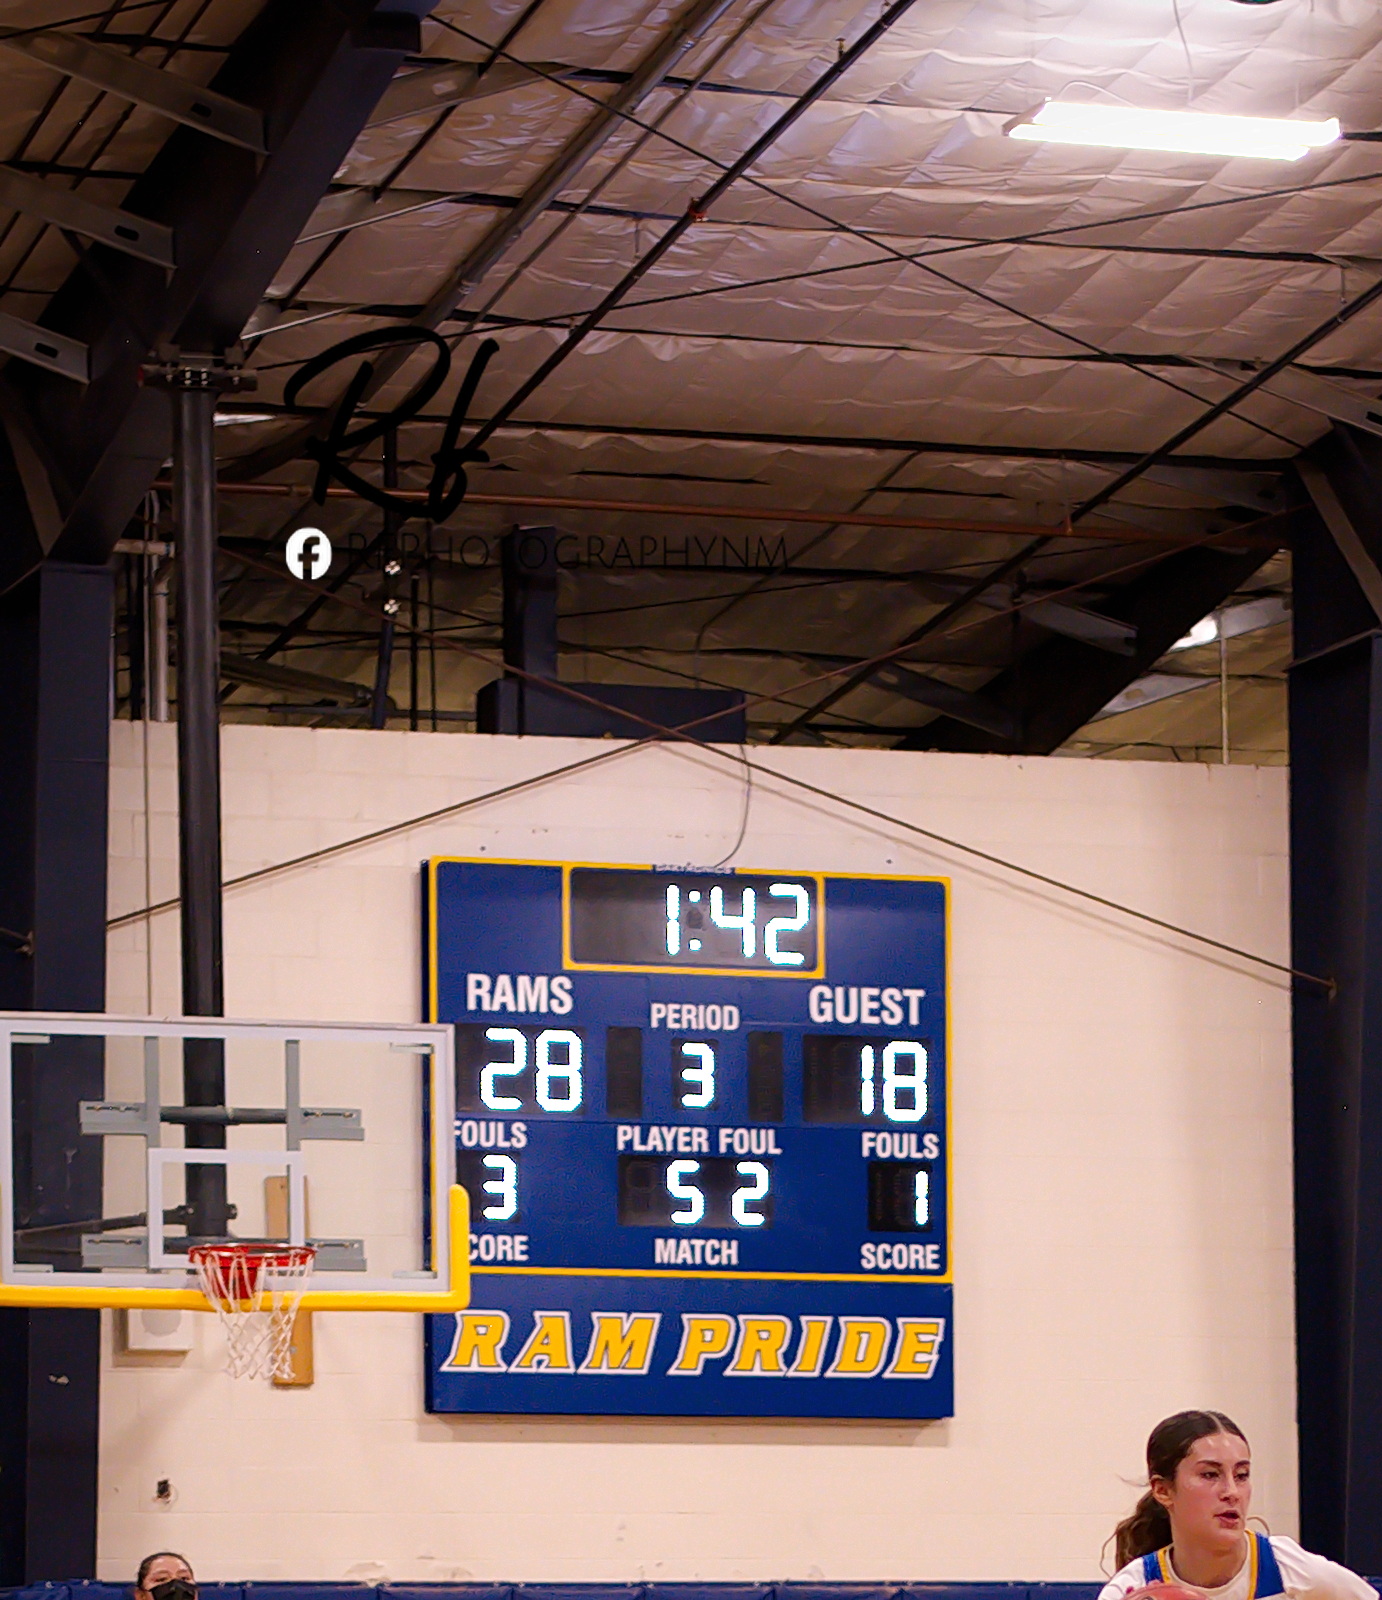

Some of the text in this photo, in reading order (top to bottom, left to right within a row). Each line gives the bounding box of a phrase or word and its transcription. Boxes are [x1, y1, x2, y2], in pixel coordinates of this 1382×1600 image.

[665, 883, 810, 966] 1:42
[466, 973, 574, 1015] RAMS
[808, 984, 926, 1026] GUEST
[650, 1003, 740, 1031] PERIOD
[480, 1027, 584, 1113] 28
[680, 1042, 716, 1108] 3
[860, 1040, 928, 1122] 18
[616, 1125, 782, 1155] PLAYER FOUL
[861, 1132, 939, 1159] FOULS
[481, 1154, 518, 1221] 3
[914, 1170, 930, 1225] 1
[470, 1234, 529, 1261] CORE
[654, 1238, 738, 1265] MATCH
[860, 1243, 940, 1269] SCORE
[440, 1309, 945, 1379] RAM PRIDE
